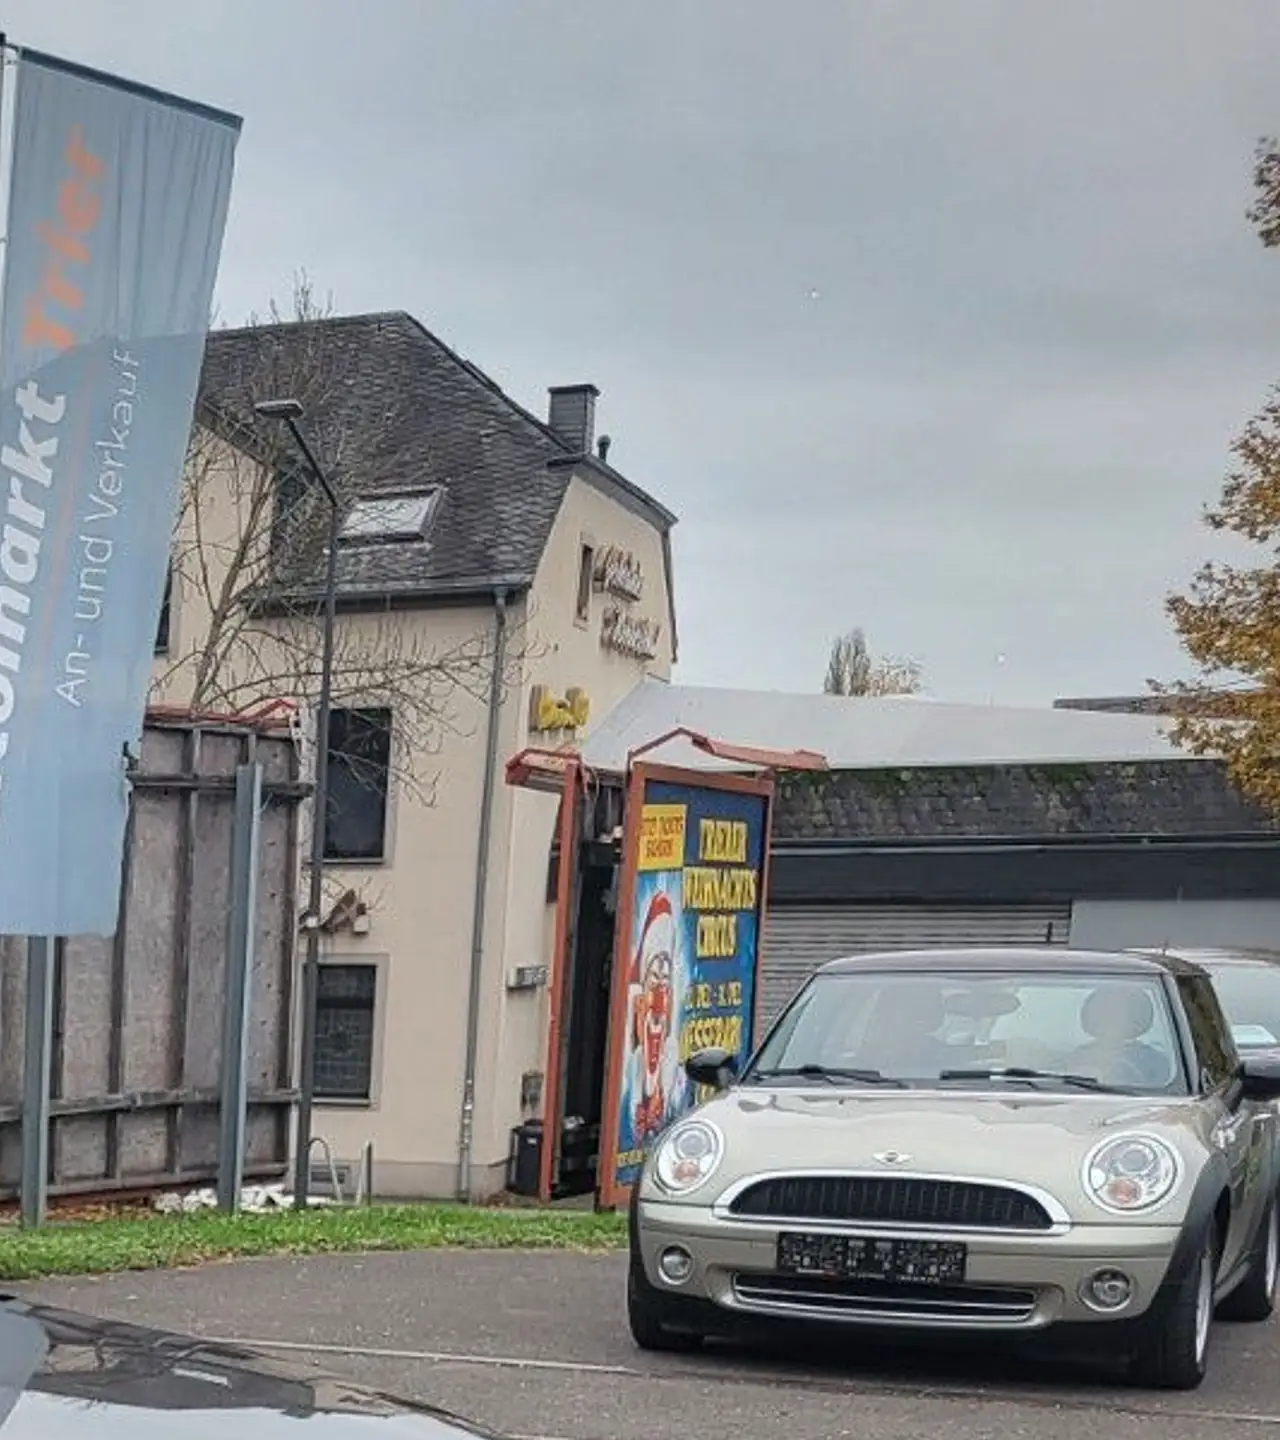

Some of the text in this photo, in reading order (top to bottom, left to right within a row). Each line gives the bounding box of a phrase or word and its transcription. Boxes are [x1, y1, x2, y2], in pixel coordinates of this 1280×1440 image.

[55, 347, 140, 709] An- und Verkauf
